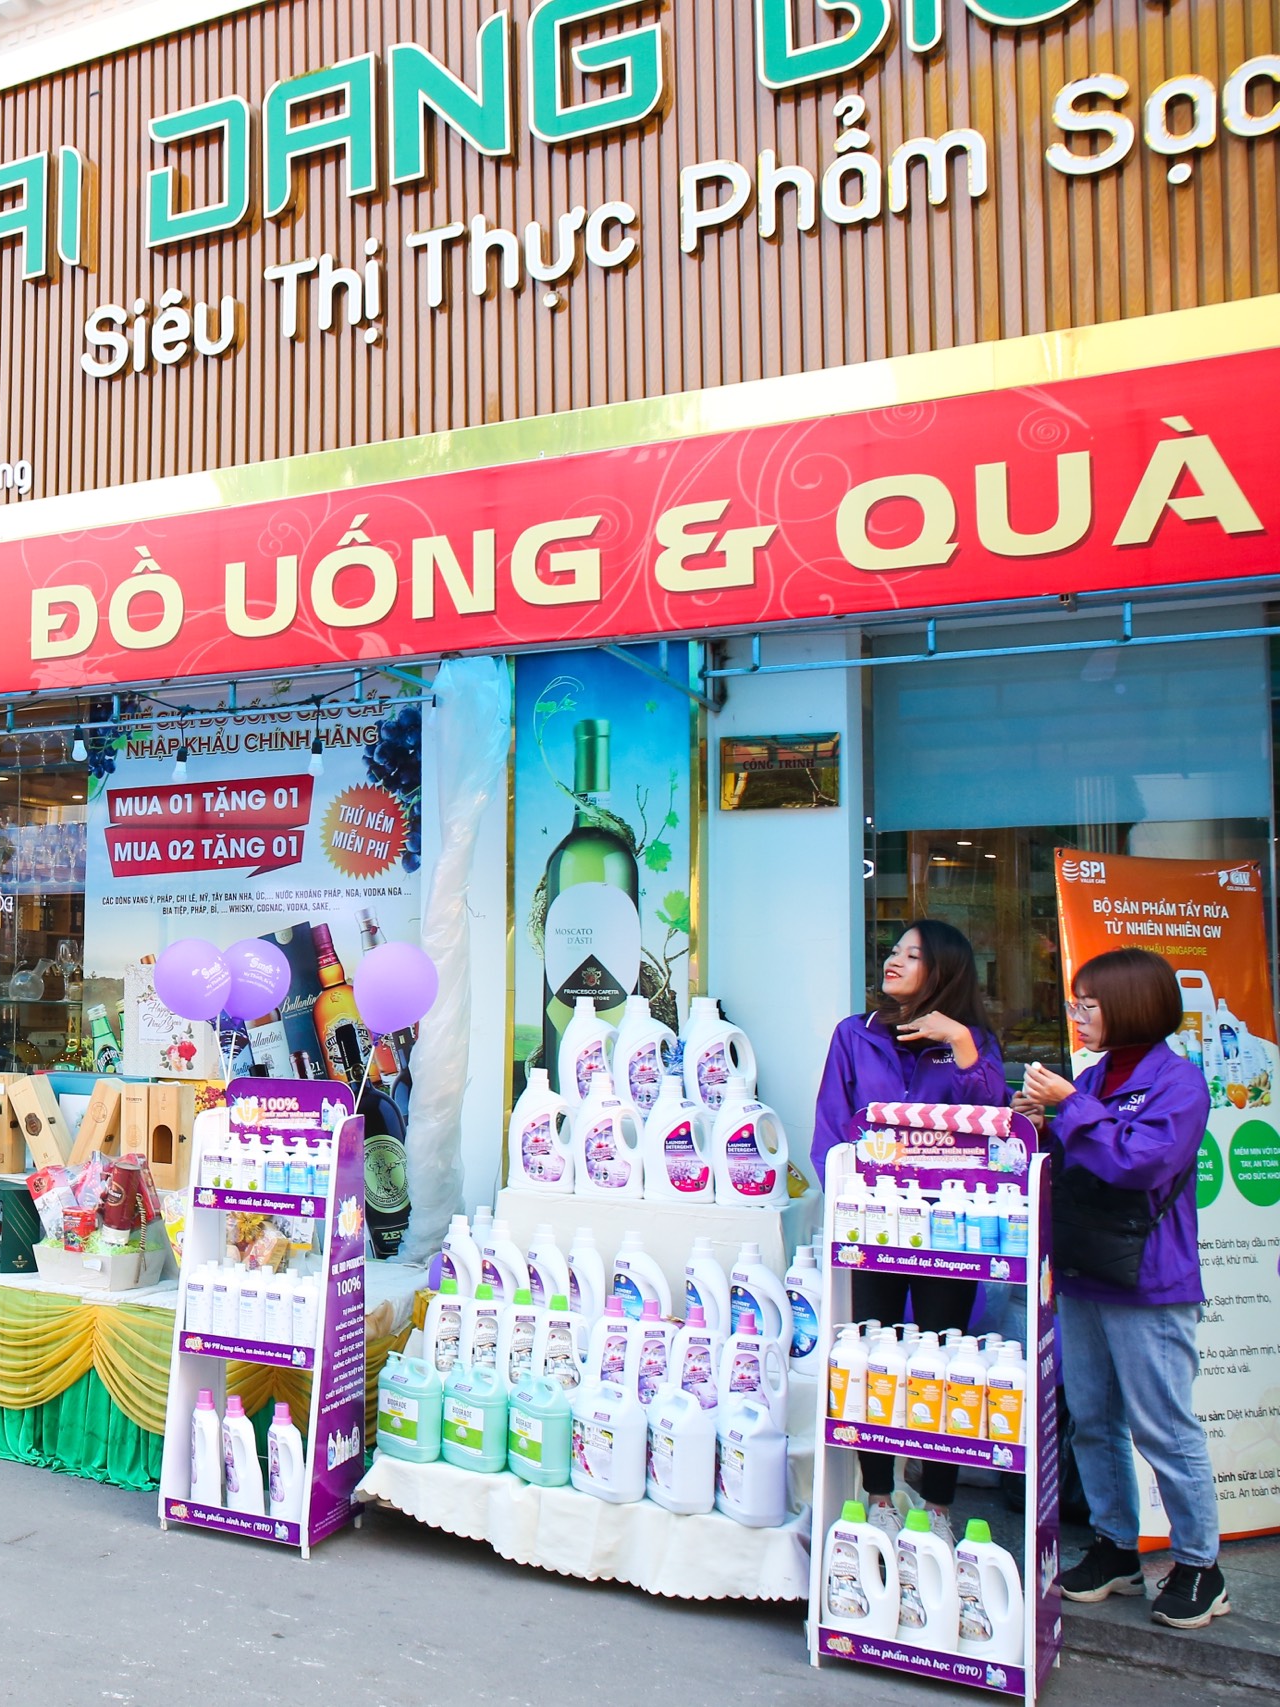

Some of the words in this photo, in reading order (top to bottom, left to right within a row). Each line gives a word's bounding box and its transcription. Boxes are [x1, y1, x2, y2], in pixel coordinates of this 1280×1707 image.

[145, 0, 664, 248] DANG
[80, 288, 238, 379] Siêu
[265, 237, 382, 345] Thị
[406, 201, 636, 308] Thực
[680, 95, 987, 253] Phẩm
[31, 545, 183, 659] ĐỒ
[225, 514, 602, 637] UỐNG
[655, 500, 778, 592] &
[837, 416, 1263, 570] QUÀ
[126, 735, 180, 761] NHẬP
[185, 726, 240, 756] KHẨU
[244, 725, 310, 752] CHÍNH
[317, 724, 378, 748] HÃNG
[743, 757, 773, 770] CÔNG
[779, 756, 814, 769] TRÌNH
[115, 795, 163, 817] MUA
[169, 794, 193, 813] 01
[202, 786, 266, 818] TẶNG
[274, 787, 299, 809] 01
[339, 803, 363, 827] THỬ
[365, 807, 394, 834] NẾM
[114, 840, 162, 862] MUA
[168, 839, 195, 860] 02
[202, 833, 265, 865] TẶNG
[272, 836, 297, 857] 01
[331, 828, 364, 852] MIỄN
[367, 837, 390, 860] PHÍ
[1079, 860, 1106, 879] SPI
[163, 906, 173, 915] BIA
[229, 904, 255, 914] WHISKY,
[256, 903, 284, 913] COGNAC,
[287, 902, 310, 912] VODKA,
[1093, 897, 1112, 917] BỘ
[1114, 898, 1140, 915] SẢN
[1142, 898, 1176, 917] PHẨM
[1178, 900, 1201, 918] TẨY
[1203, 902, 1229, 919] RỬA
[1104, 918, 1123, 934] TỪ
[1126, 919, 1163, 936] NHIÊN
[1166, 920, 1201, 937] NHIÊN
[1202, 925, 1221, 938] GW
[1167, 945, 1207, 956] SINGAPORE
[260, 1096, 299, 1111] 100%
[900, 1130, 955, 1147] 100%
[1215, 1239, 1235, 1249] Đánh
[1236, 1238, 1250, 1250] bay
[1252, 1236, 1266, 1247] dầu
[1268, 1236, 1280, 1246] mỡ
[877, 1253, 895, 1264] Sản
[896, 1254, 918, 1266] xuất
[919, 1256, 932, 1268] tại
[933, 1255, 981, 1272] Singapore
[336, 1275, 362, 1296] 100%
[1207, 1346, 1218, 1358] Áo
[1219, 1346, 1238, 1359] quần
[1240, 1344, 1259, 1355] mềm
[1260, 1344, 1276, 1355] mịn,
[1204, 1364, 1225, 1375] nước
[1227, 1365, 1237, 1375] xả
[387, 1398, 407, 1410] BIOGRADE
[452, 1406, 472, 1418] BIOGRADE
[515, 1417, 532, 1429] BIOGRADE
[1209, 1410, 1225, 1421] sàn:
[1227, 1409, 1242, 1420] Diệt
[1244, 1407, 1267, 1418] khuẩn
[860, 1431, 872, 1443] Độ
[872, 1432, 884, 1443] PH
[885, 1435, 904, 1449] trung
[934, 1442, 951, 1453] toàn
[952, 1445, 965, 1455] cho
[966, 1446, 976, 1456] da
[978, 1448, 991, 1460] tay
[1218, 1471, 1236, 1483] bình
[1238, 1471, 1257, 1481] sữa:
[1259, 1468, 1276, 1480] Loại
[861, 1644, 881, 1658] Sản
[882, 1648, 909, 1663] phẩm
[911, 1653, 931, 1667] sinh
[933, 1658, 950, 1671] học
[953, 1663, 982, 1679] (BIO)
